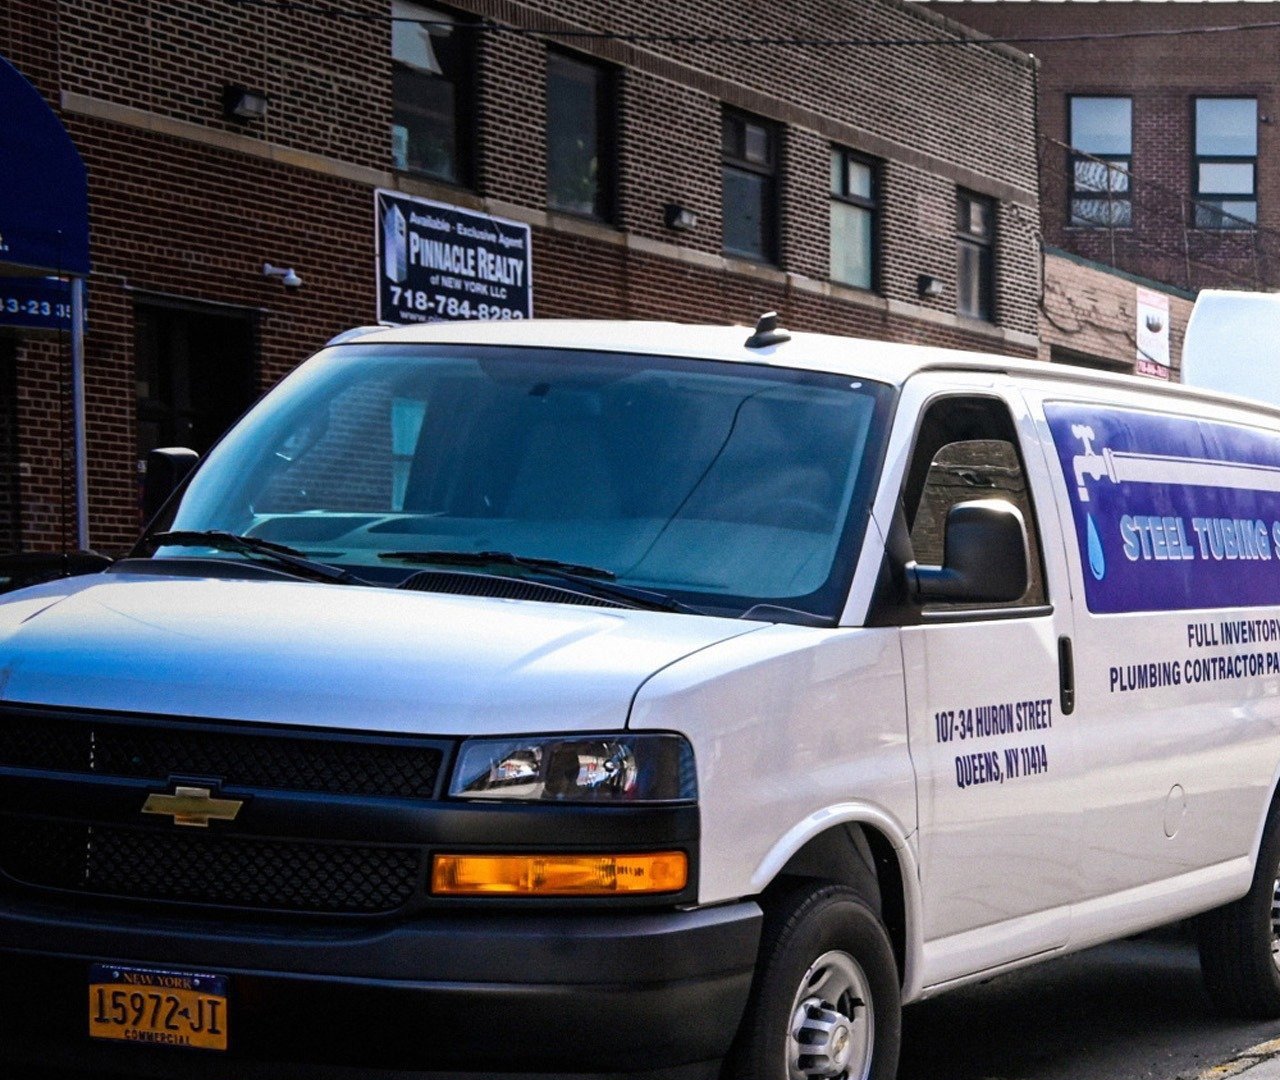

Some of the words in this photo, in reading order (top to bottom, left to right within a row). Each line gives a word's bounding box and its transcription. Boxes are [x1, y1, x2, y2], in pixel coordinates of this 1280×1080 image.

[409, 231, 476, 277] PINNACLE
[477, 246, 524, 287] REALTY
[429, 275, 440, 285] of
[441, 276, 462, 289] NEW
[464, 281, 489, 296] YORK
[489, 286, 507, 299] LLC
[1120, 514, 1194, 561] STEEL
[1192, 517, 1272, 561] TUBING
[1187, 622, 1218, 648] FULL
[1109, 661, 1181, 693] PLUMBING
[1184, 651, 1264, 684] CONTRACTOR
[935, 709, 974, 743] 107-34
[975, 703, 1014, 738] HURON
[1016, 699, 1052, 732] STREET
[955, 751, 1004, 789] QUEENS,
[1004, 748, 1019, 779] NY
[1021, 745, 1048, 776] 11414
[123, 973, 152, 985] NEW
[157, 976, 192, 989] YORK
[124, 1029, 192, 1045] COMMERCIAL
